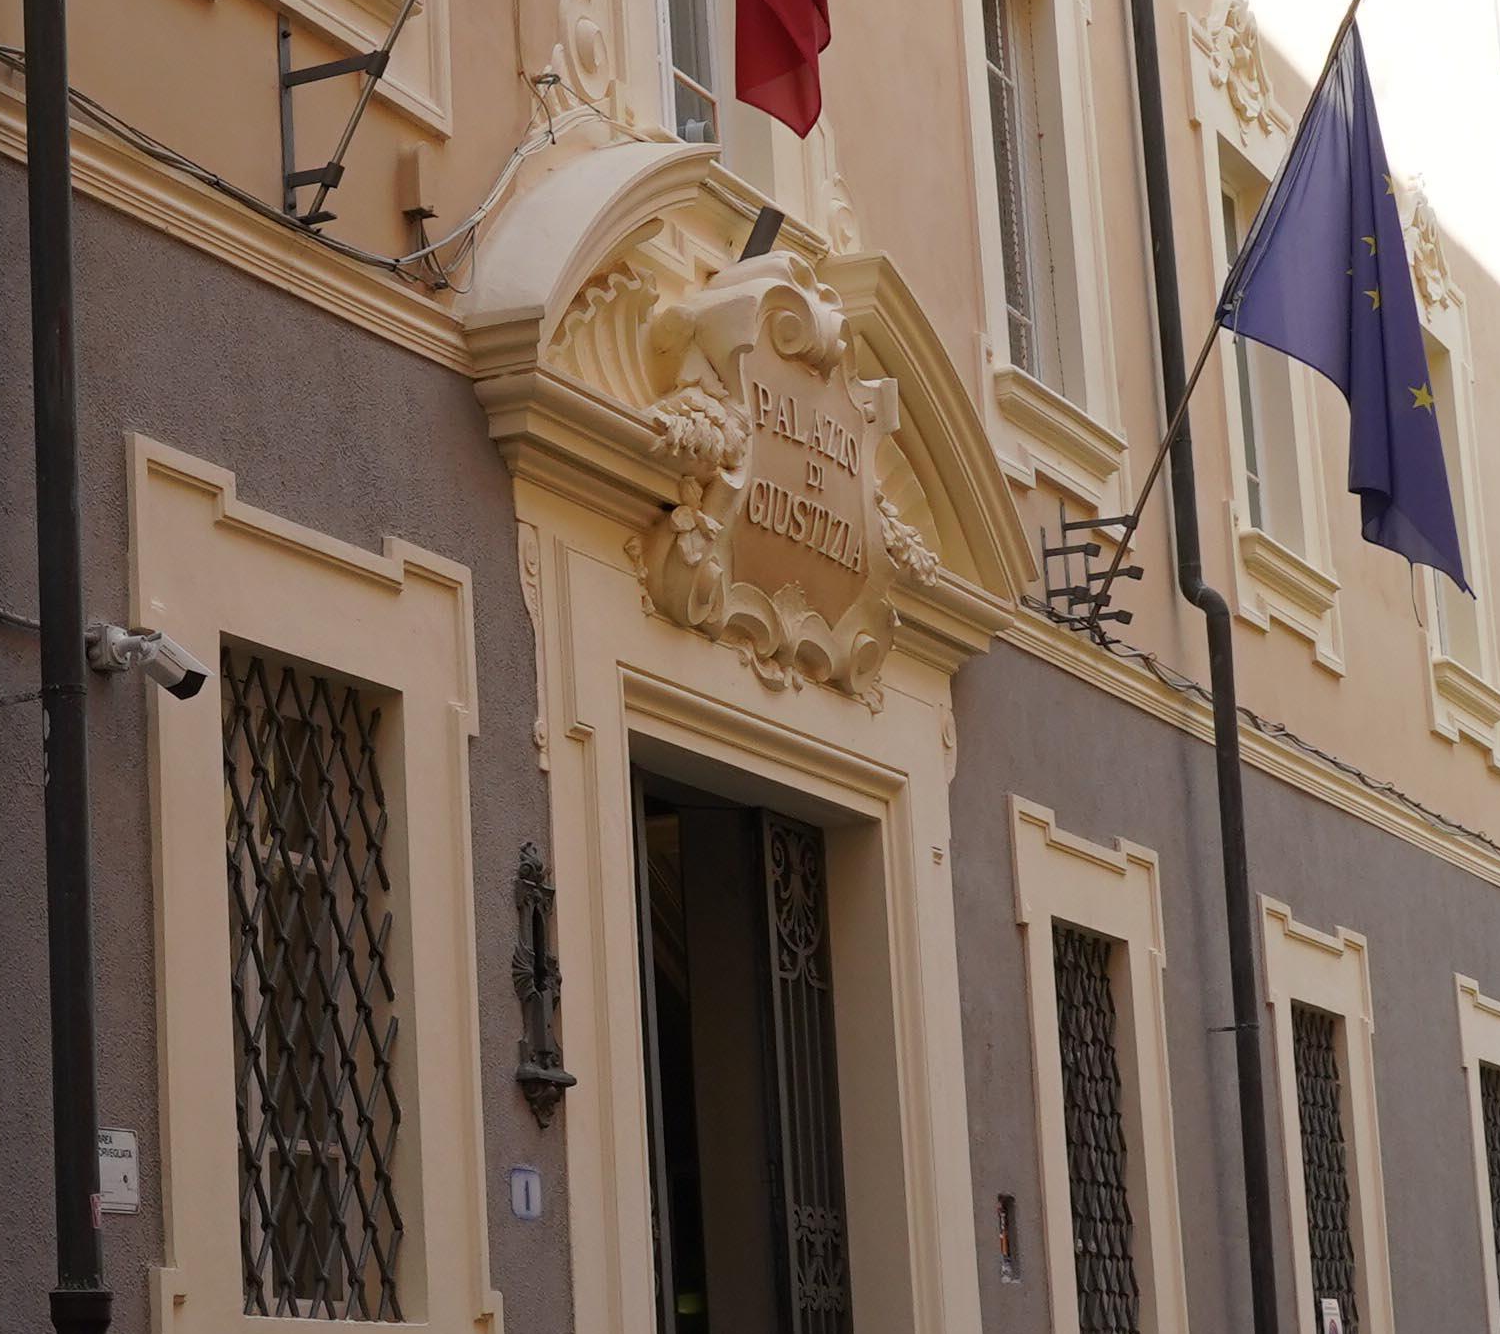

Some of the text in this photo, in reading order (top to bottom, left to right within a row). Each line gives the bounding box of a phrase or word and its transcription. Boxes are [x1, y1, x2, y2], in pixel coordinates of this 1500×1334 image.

[752, 380, 860, 476] PALAZZO
[807, 460, 824, 491] DI
[747, 477, 863, 573] GIUSTIZIA
